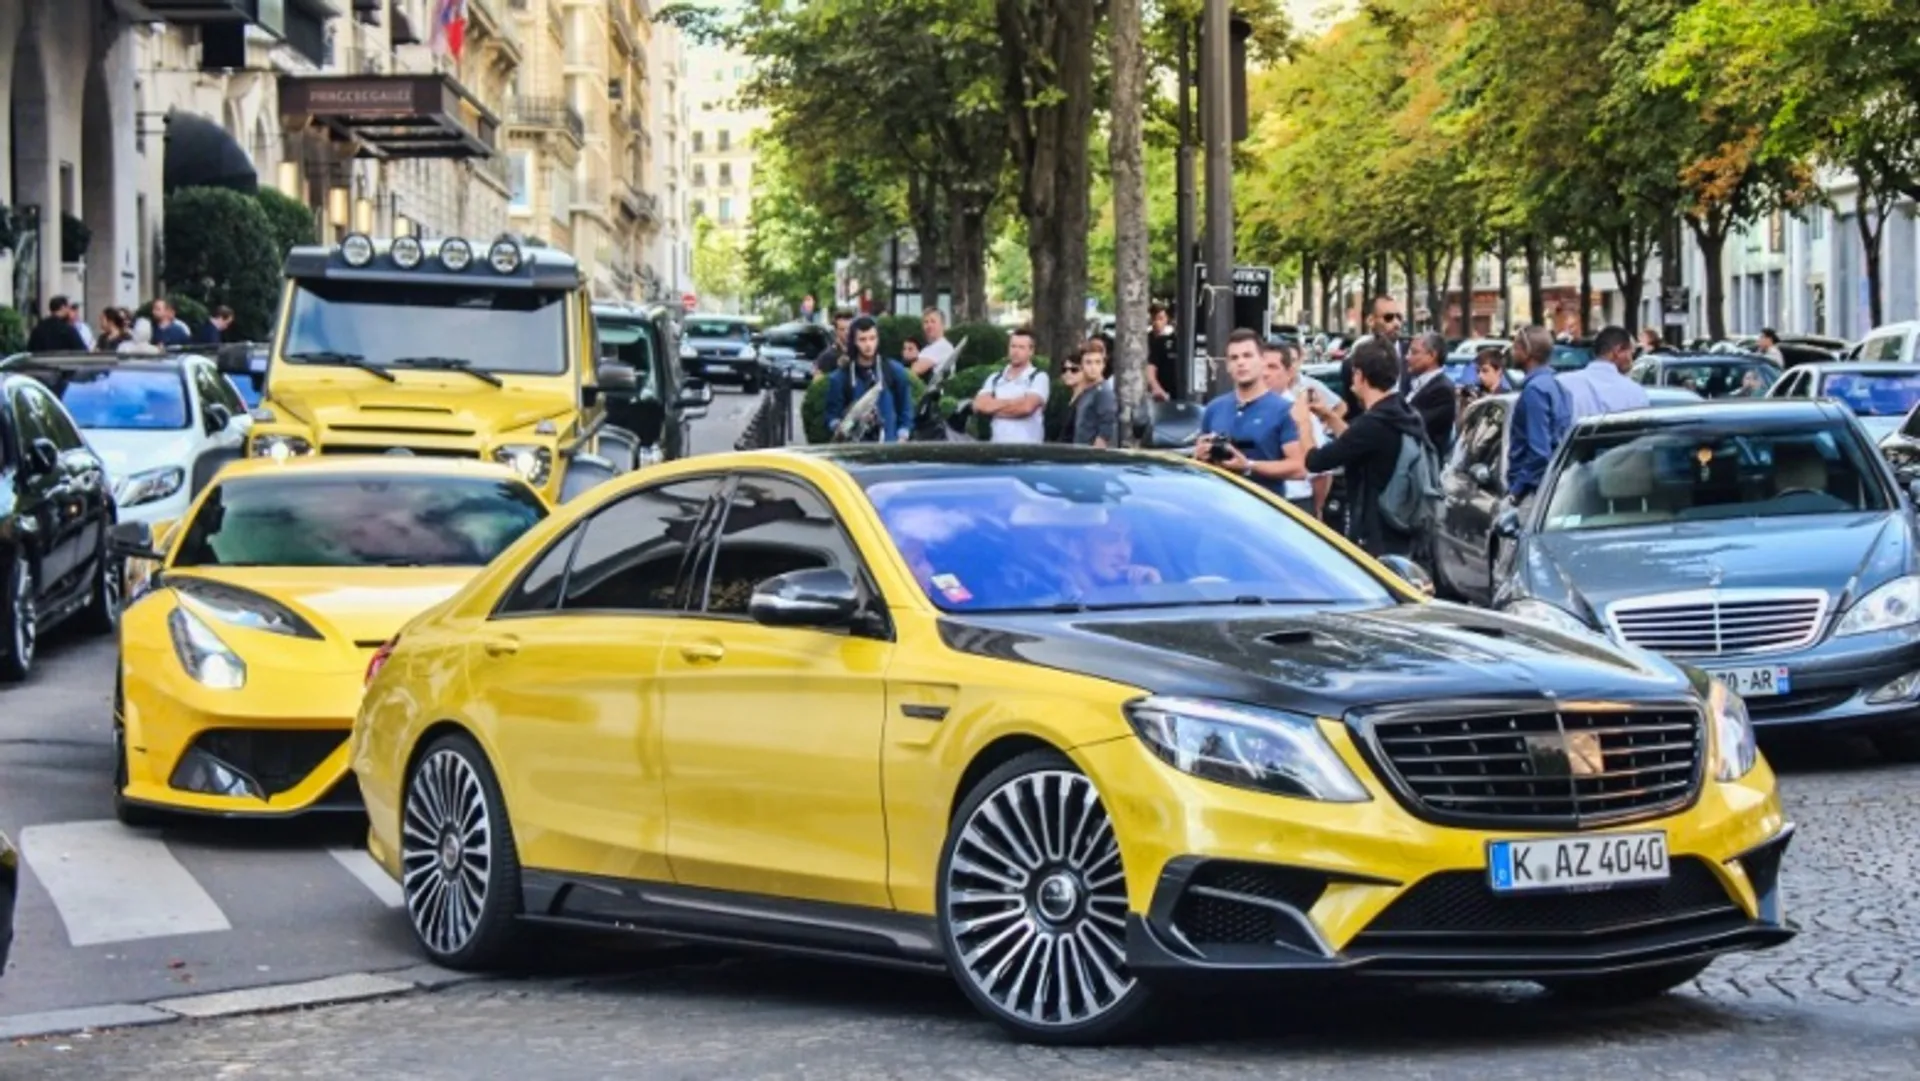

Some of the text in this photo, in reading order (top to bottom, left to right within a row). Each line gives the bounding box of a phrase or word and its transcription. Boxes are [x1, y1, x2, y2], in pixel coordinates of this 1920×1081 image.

[1513, 846, 1532, 881] K
[1555, 842, 1593, 878] AZ
[1600, 837, 1664, 875] 4040
